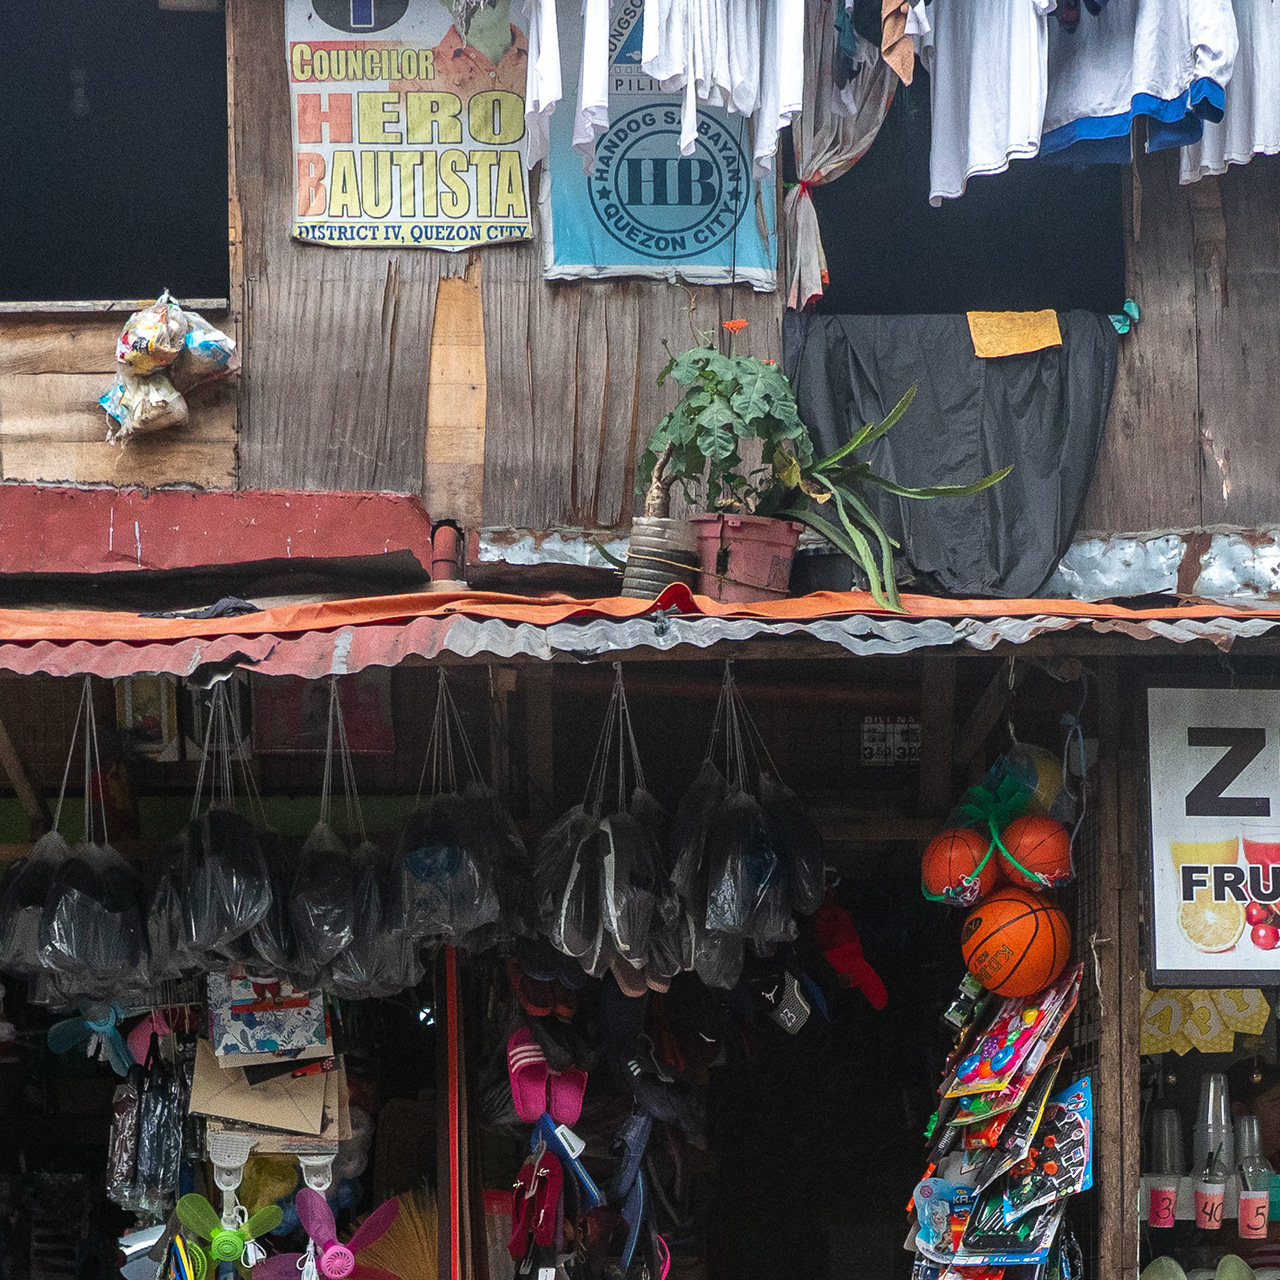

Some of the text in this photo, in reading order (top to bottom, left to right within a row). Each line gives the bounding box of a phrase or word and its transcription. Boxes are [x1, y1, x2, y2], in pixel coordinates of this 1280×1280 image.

[292, 43, 435, 81] COUNCILOR
[297, 90, 526, 145] HERO
[594, 112, 657, 182] HANDOG
[696, 120, 742, 183] BAYAN
[297, 150, 529, 219] BAUTISTA
[622, 158, 717, 206] HB
[297, 225, 528, 244] DISTRICT IV, QUEZON CITY
[603, 200, 735, 252] QUEZON CITY
[779, 1008, 797, 1028] 23
